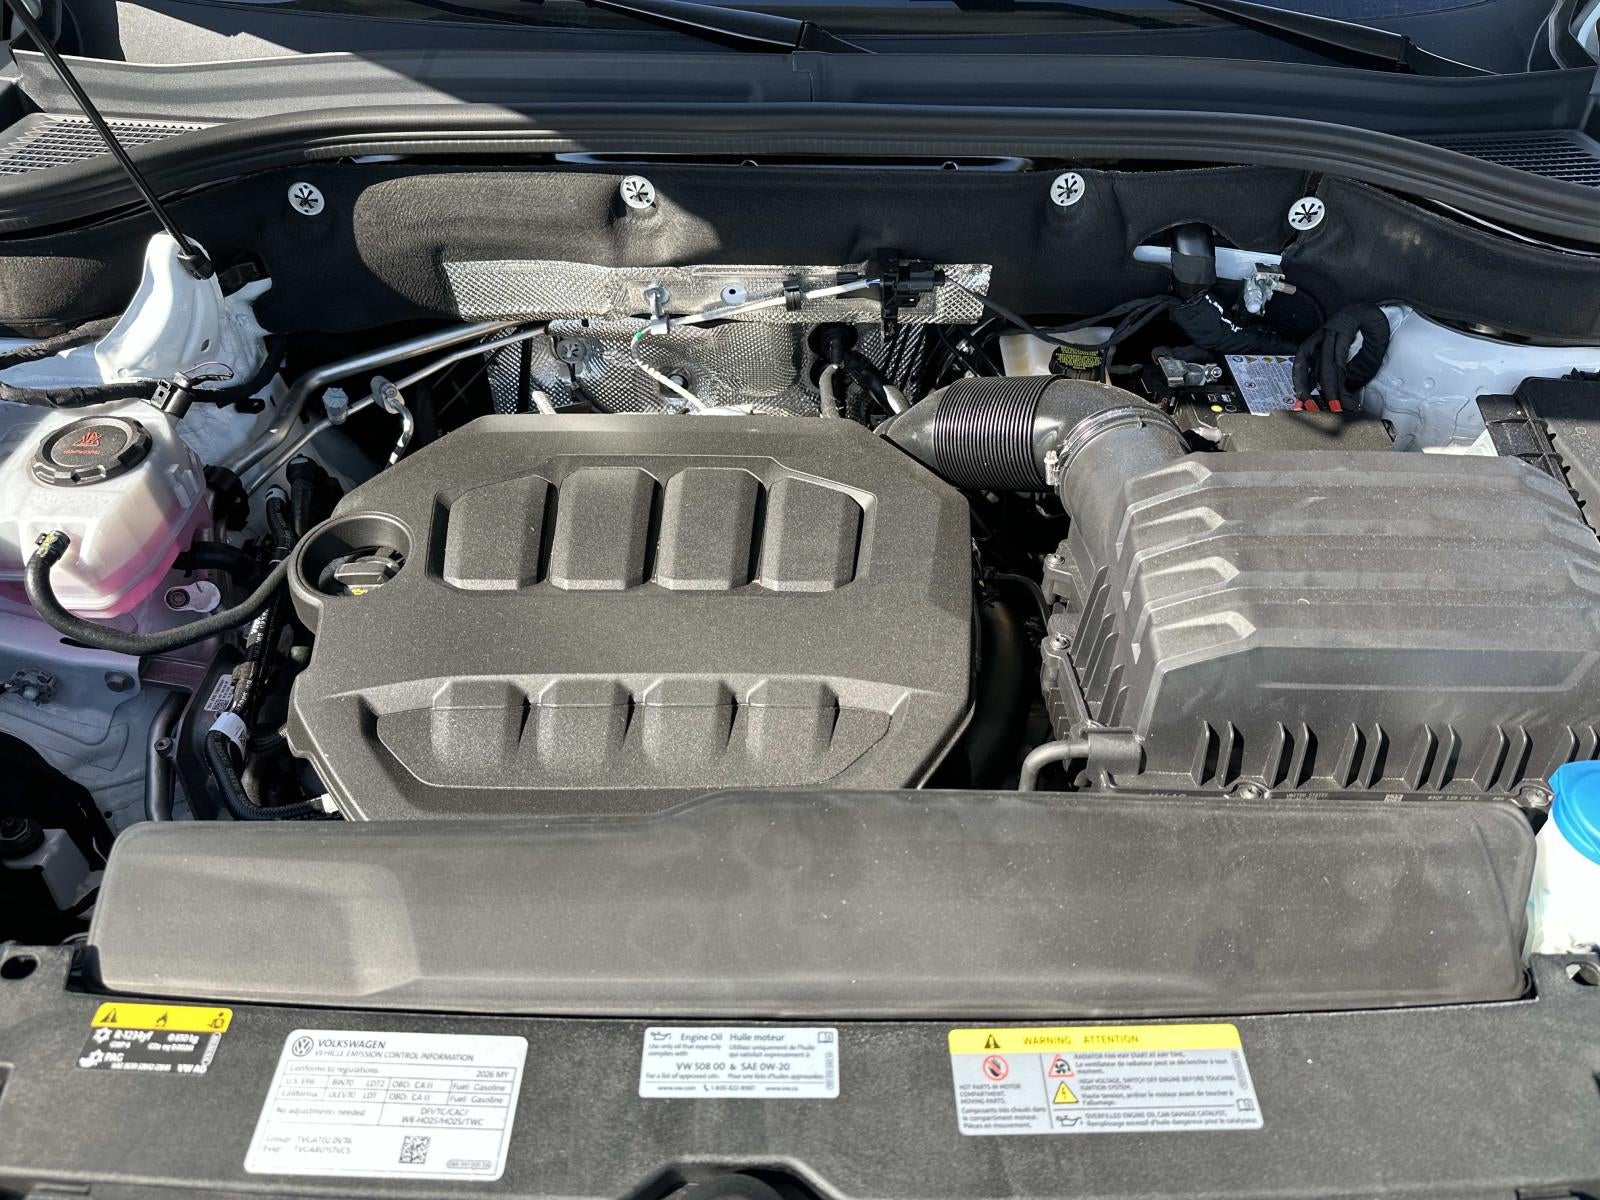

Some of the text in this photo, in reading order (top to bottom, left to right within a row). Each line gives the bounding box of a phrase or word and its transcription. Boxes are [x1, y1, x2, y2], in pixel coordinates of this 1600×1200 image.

[680, 1032, 723, 1043] Engine Oil
[730, 1032, 785, 1041] Huile moteur
[1023, 1034, 1139, 1045] WARNING ATTENTION
[318, 1038, 387, 1049] VOLKSWAGEN
[315, 1049, 474, 1062] VEHICLE EMISSION CONTROL INFORMATION
[290, 1065, 326, 1073] Conforms
[337, 1066, 379, 1075] regulations
[676, 1062, 791, 1071] VW 508 00 & SAE 0W-20
[475, 1070, 509, 1079] 2026 MY
[473, 1083, 506, 1092] Gasoline
[411, 1093, 422, 1101] CA
[471, 1095, 504, 1104] Gasoline
